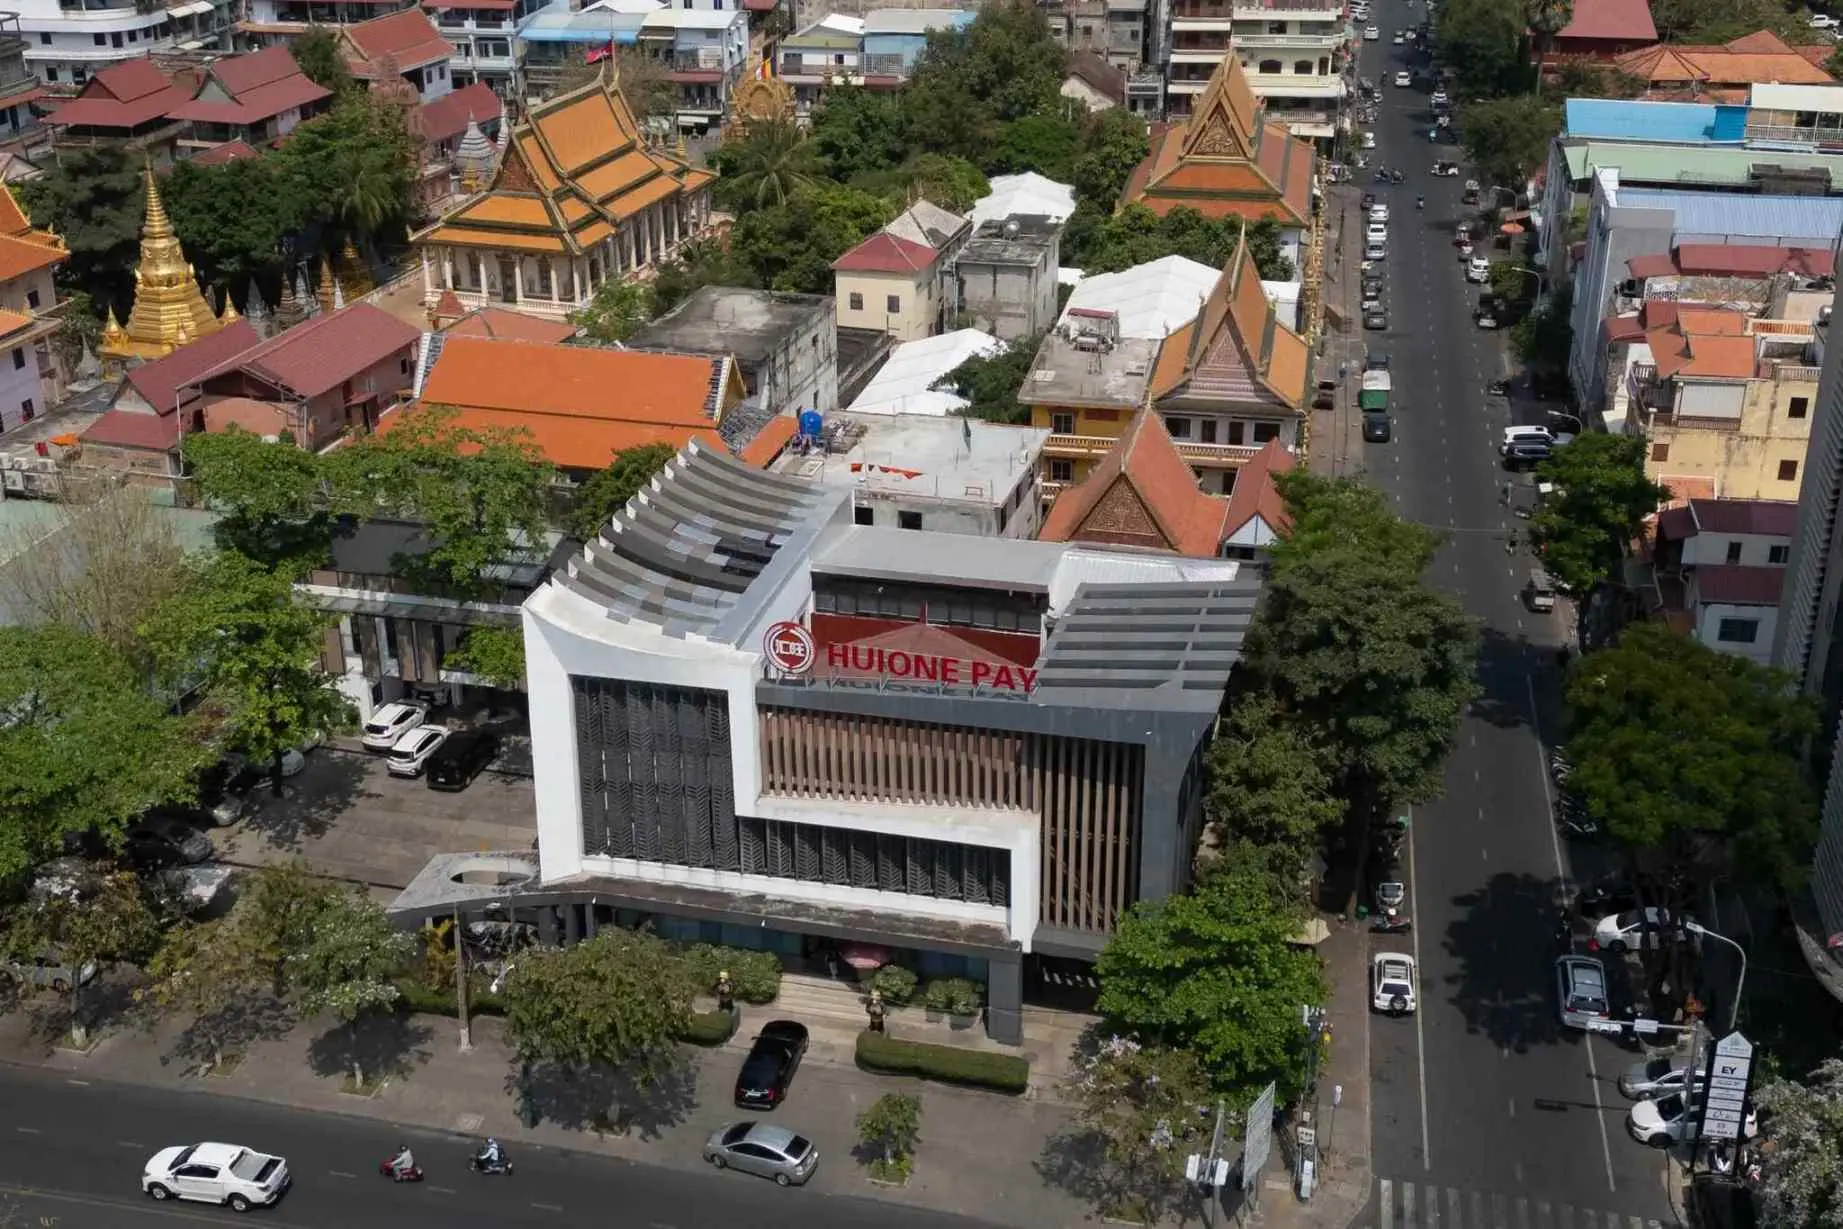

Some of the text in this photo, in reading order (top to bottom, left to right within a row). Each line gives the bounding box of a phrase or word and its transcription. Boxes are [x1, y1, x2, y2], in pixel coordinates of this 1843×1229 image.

[828, 643, 1037, 692] HUIONE PAY
[1721, 1066, 1737, 1075] EY
